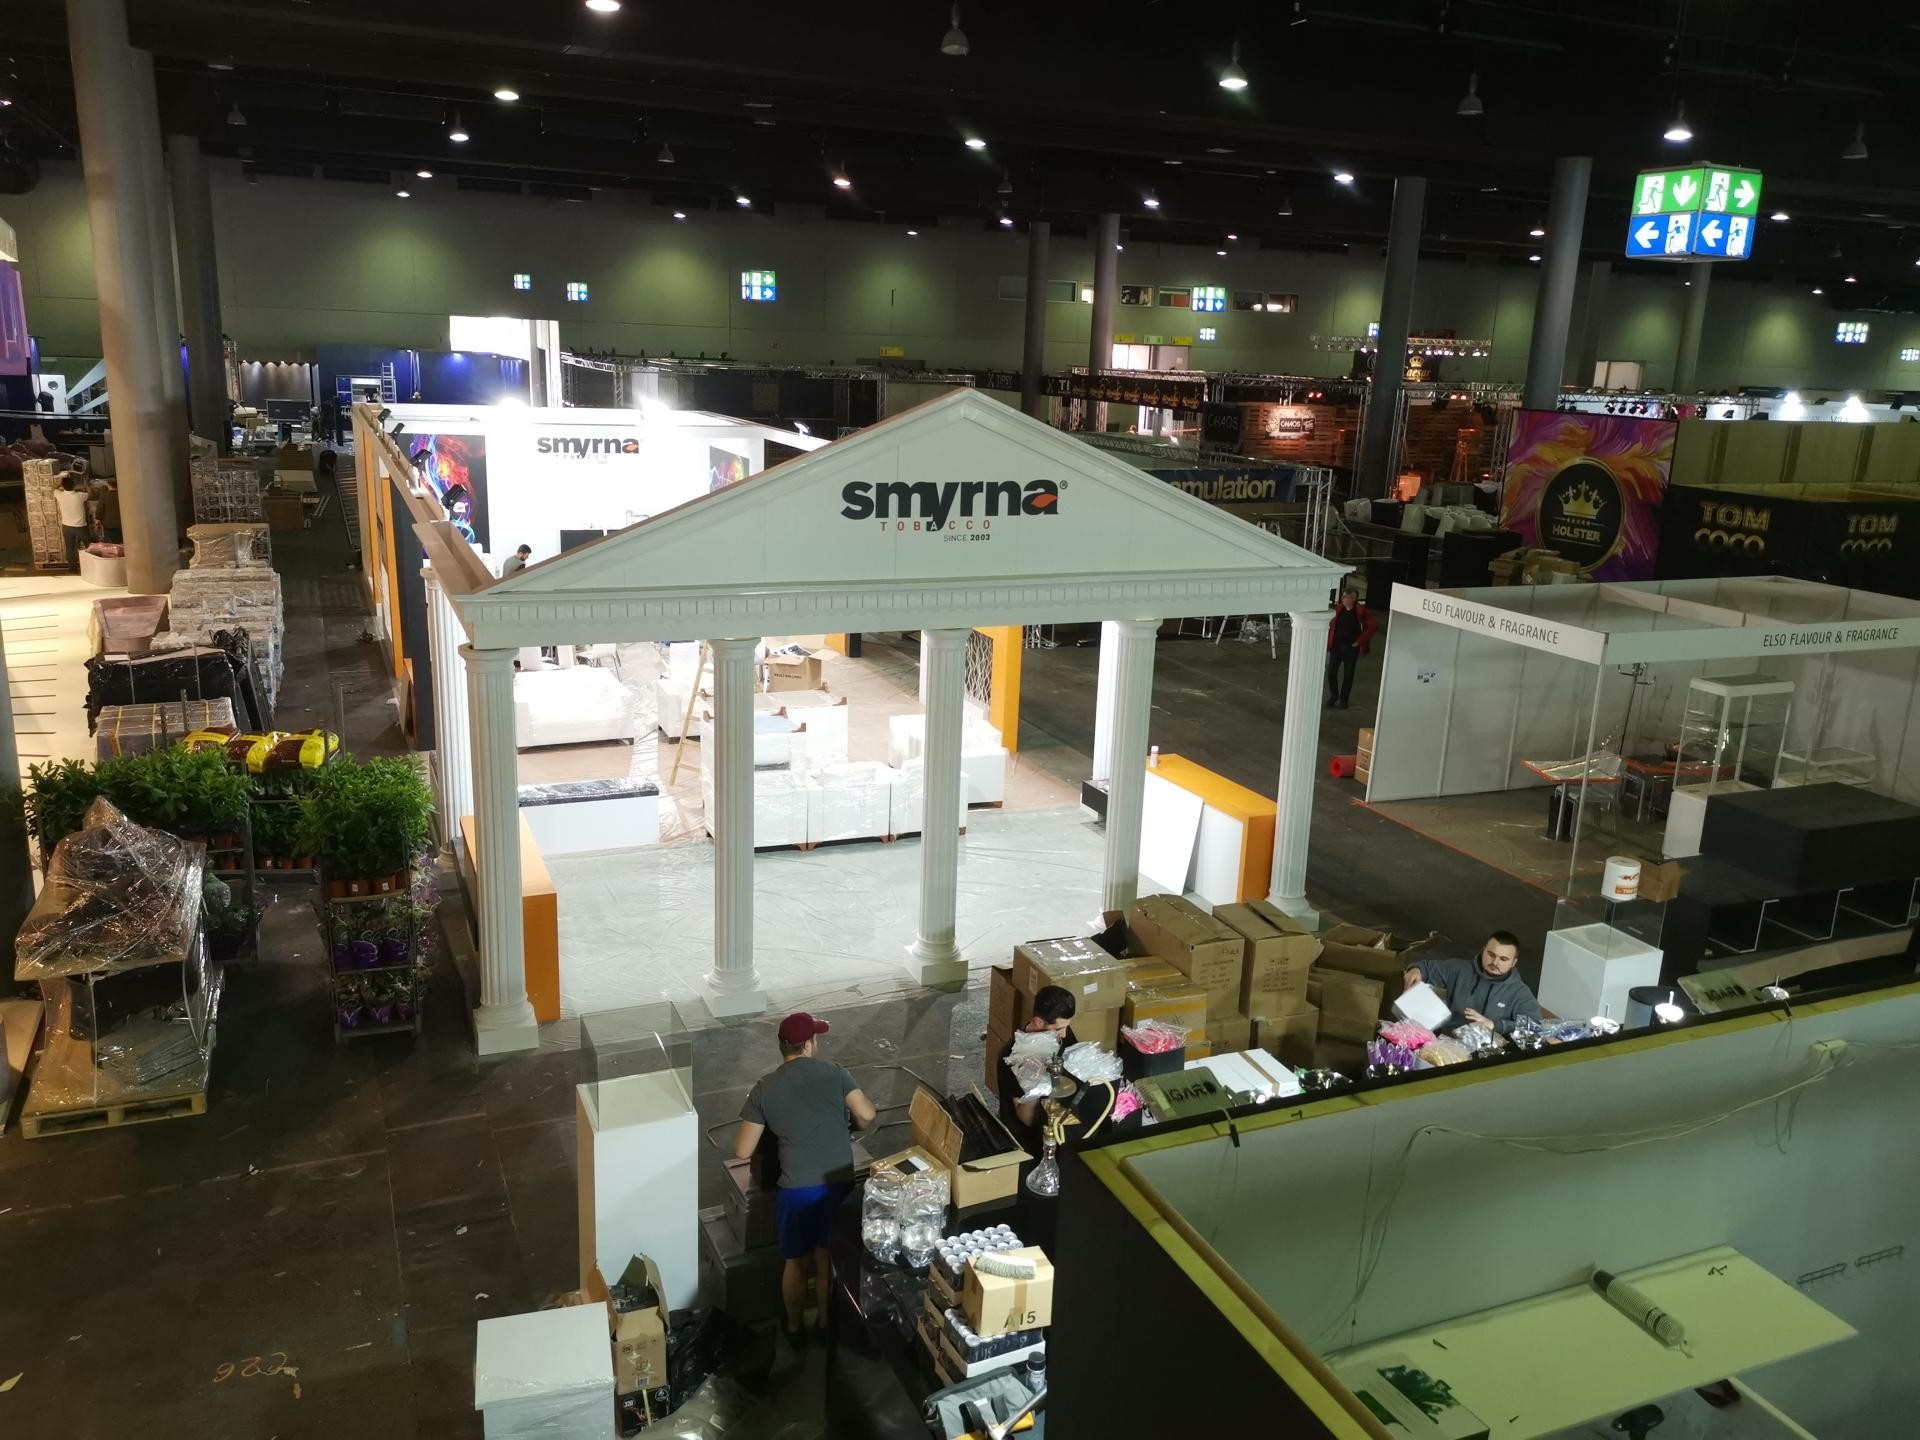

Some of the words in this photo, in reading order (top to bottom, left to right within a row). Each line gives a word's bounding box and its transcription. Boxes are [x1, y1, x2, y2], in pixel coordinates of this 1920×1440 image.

[537, 437, 639, 459] smyrna
[840, 479, 1060, 532] smyrna
[880, 519, 991, 532] TOBACCO
[1701, 502, 1771, 531] TOM
[1847, 514, 1898, 533] TOM
[943, 534, 967, 542] SINCE
[970, 533, 991, 541] 2003
[1552, 524, 1601, 542] HOLSTER
[1422, 598, 1442, 614] ELSO
[1445, 604, 1485, 626] FLAVOUR
[1488, 616, 1496, 629] &
[1500, 618, 1559, 645] FRAGRANCE
[1763, 633, 1787, 647] ELSO
[1790, 631, 1832, 646] FLAVOUR
[1835, 631, 1842, 643] &
[1846, 627, 1899, 642] FRAGRANCE
